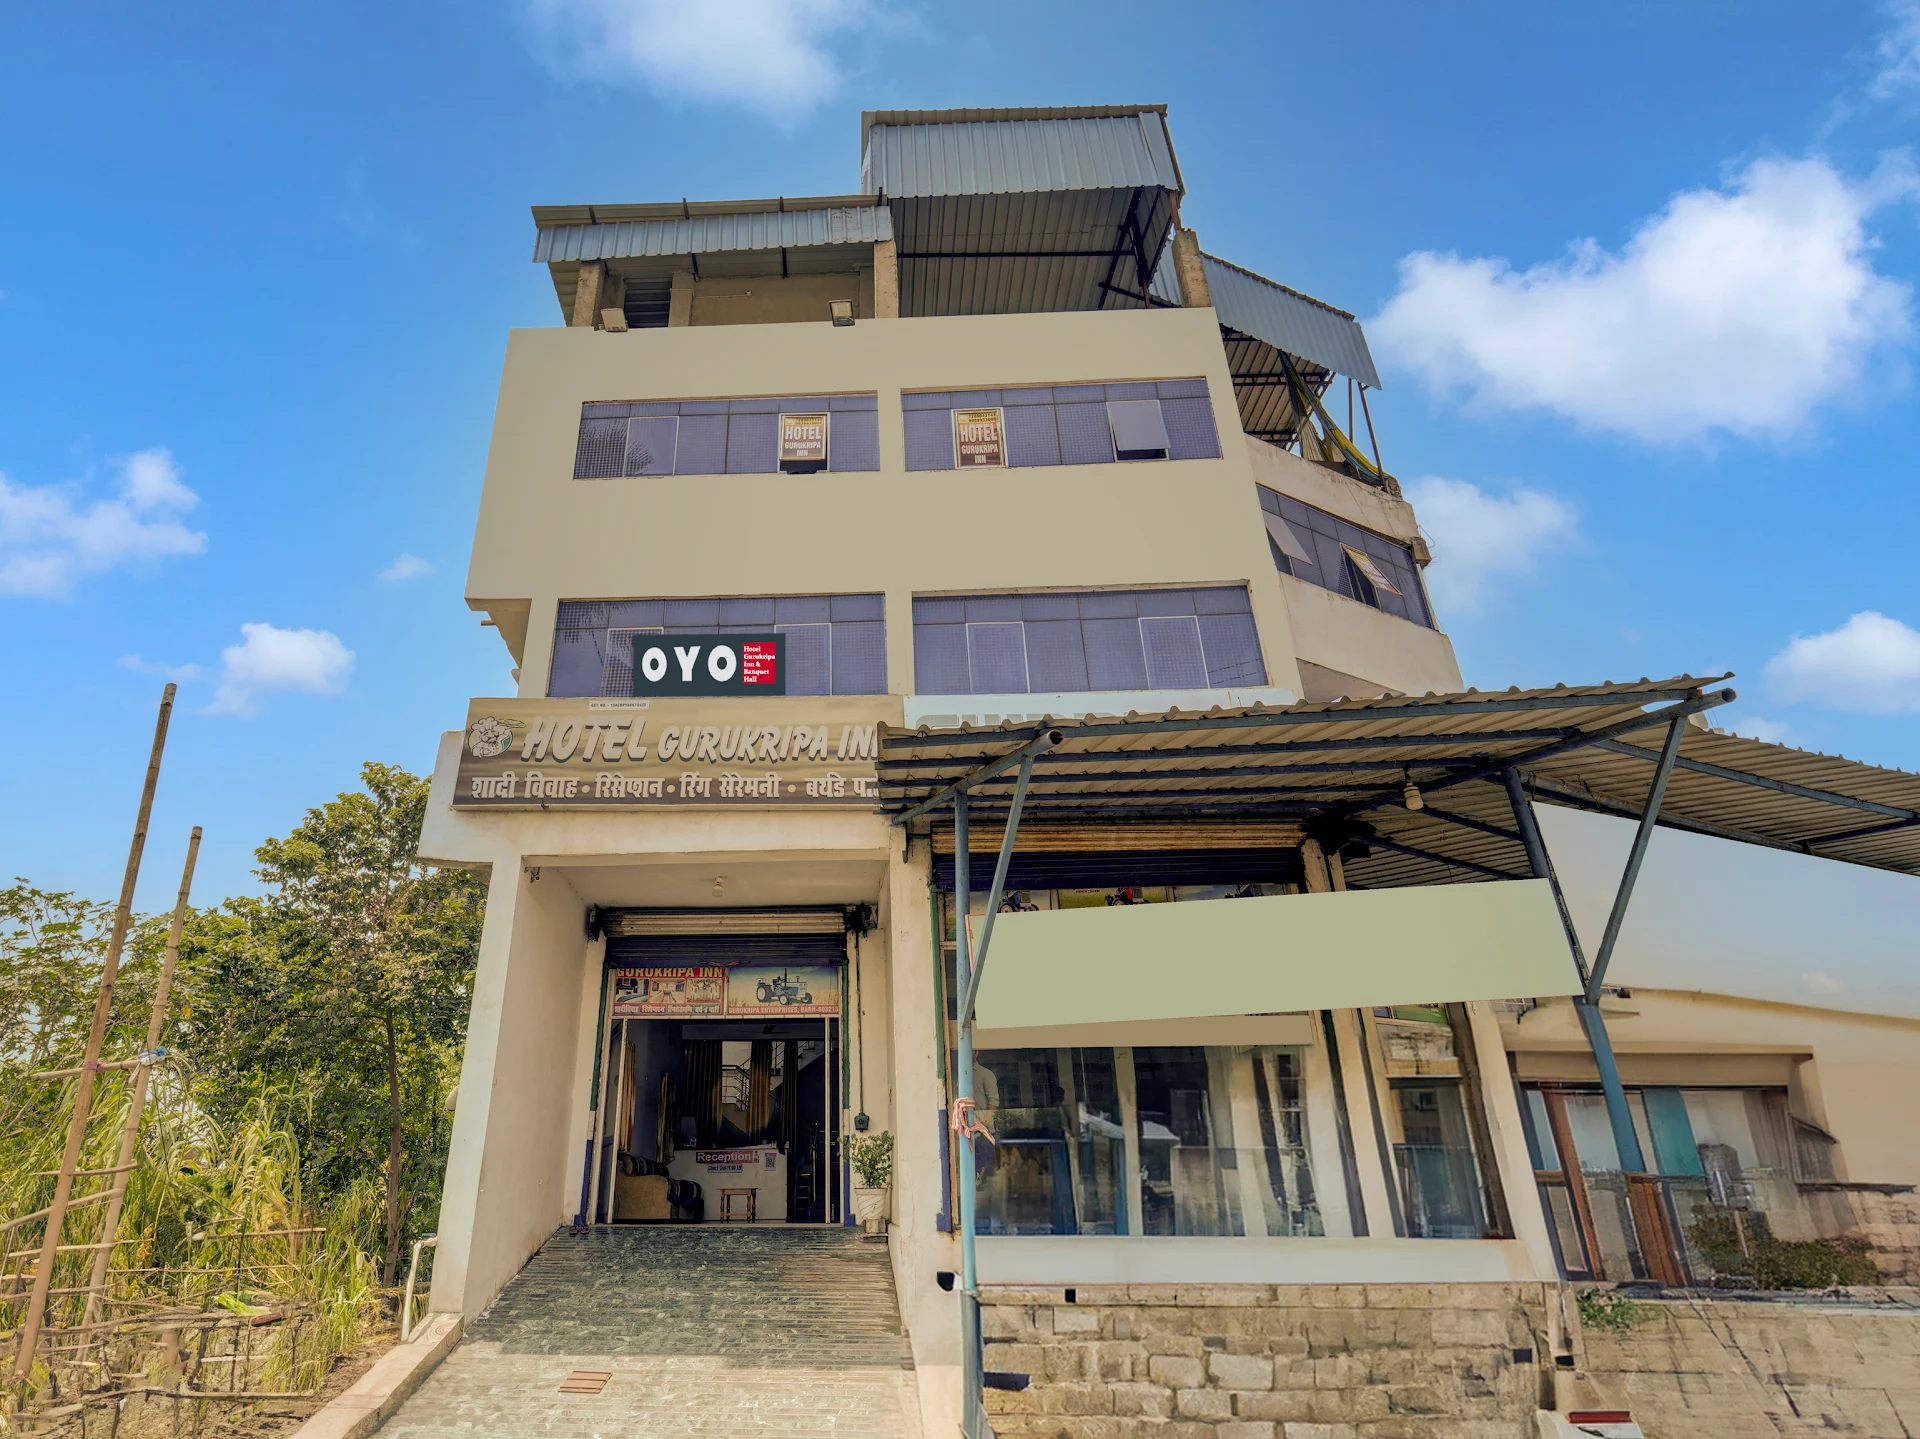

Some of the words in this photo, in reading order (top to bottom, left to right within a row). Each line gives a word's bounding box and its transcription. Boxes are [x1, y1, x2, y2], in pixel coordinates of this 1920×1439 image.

[785, 426, 822, 440] HOTEL
[960, 423, 998, 442] HOTEL
[785, 441, 821, 449] GURUKRIPA
[961, 444, 999, 454] GURUKRIPA
[974, 455, 987, 463] INN
[641, 645, 737, 682] OYO
[521, 715, 649, 762] HOTEL
[657, 724, 829, 763] GURUKRIPA
[471, 770, 519, 798] शादी
[524, 770, 580, 798] विवाह
[594, 771, 666, 798] रिसेप्शन
[679, 771, 712, 798] रिंग
[718, 771, 782, 798] सेरेमनी
[618, 967, 695, 978] GURUKRIPA
[699, 967, 723, 978] INN
[697, 1152, 752, 1163] Reception
